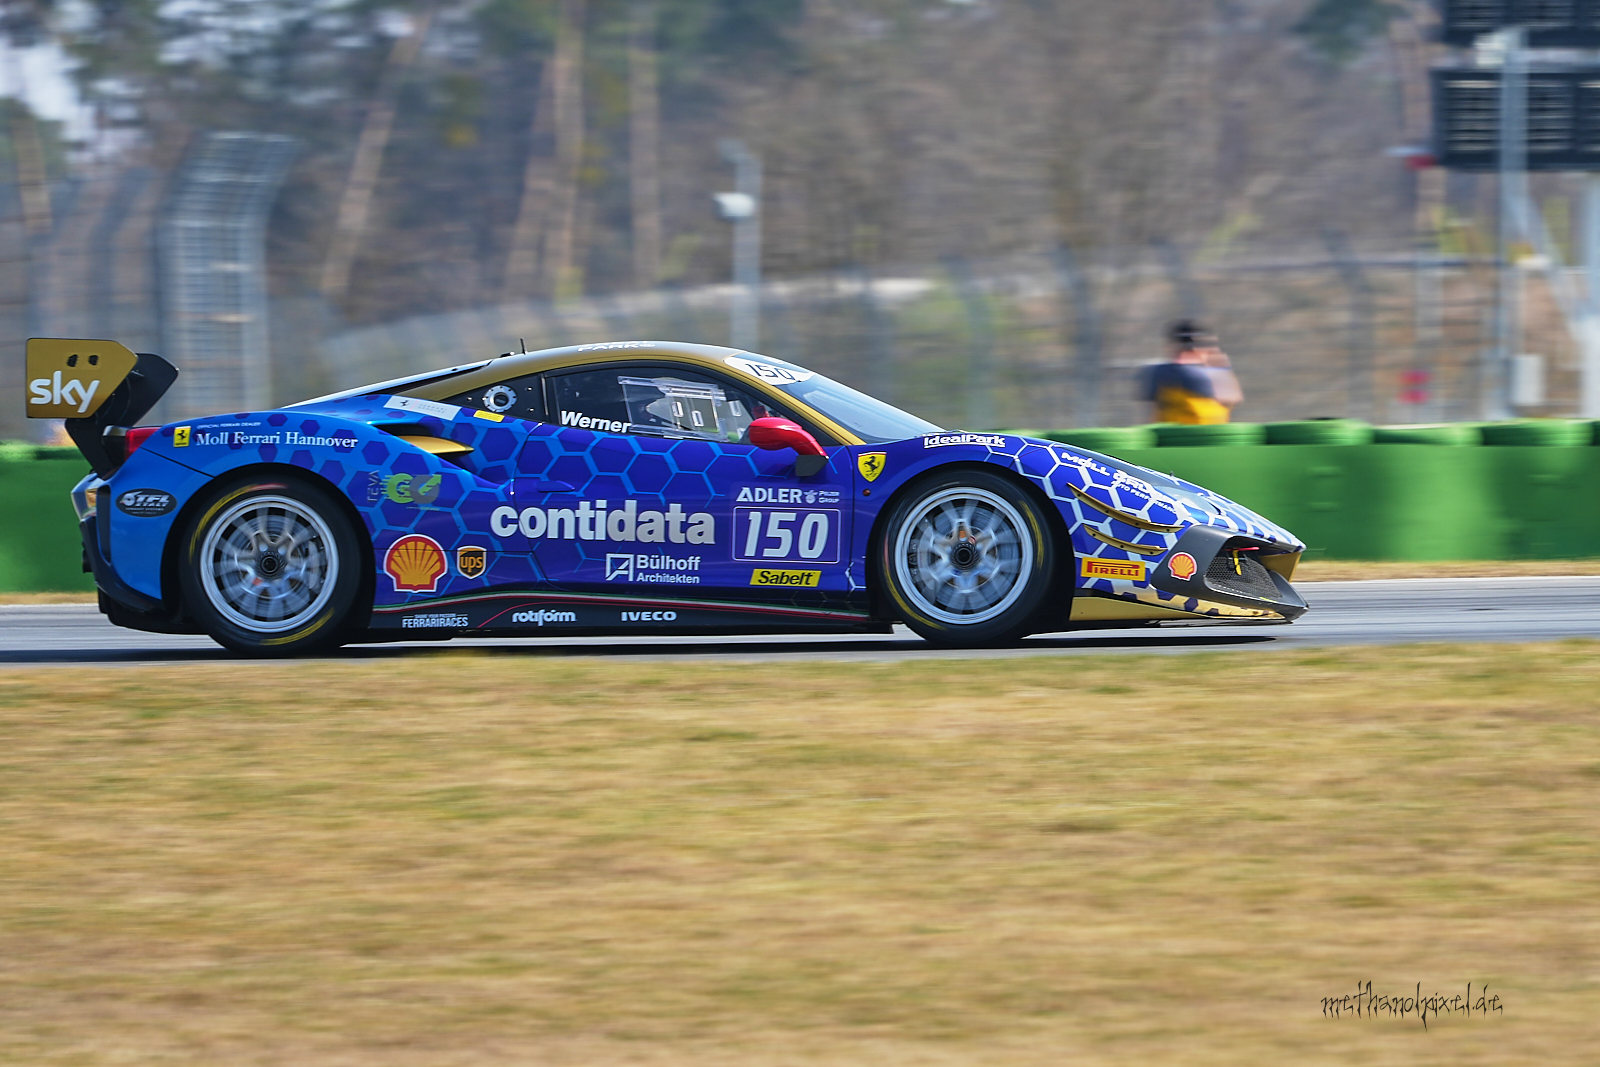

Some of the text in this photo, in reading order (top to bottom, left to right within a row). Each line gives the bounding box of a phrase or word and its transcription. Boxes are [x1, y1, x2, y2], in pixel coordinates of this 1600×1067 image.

[746, 363, 796, 380] 150
[29, 370, 100, 413] sky
[561, 410, 632, 433] Werner
[196, 431, 358, 448] Moll Ferrari Hannover
[924, 434, 1006, 446] IdealPark
[736, 487, 803, 504] ADLER
[490, 500, 716, 544] contidata
[744, 511, 829, 559] 150
[460, 556, 484, 573] ups
[636, 554, 701, 571] Bülhoff
[1087, 561, 1140, 577] PIRELLI
[636, 572, 700, 584] Architekten
[758, 570, 814, 586] Sabelt
[402, 617, 468, 628] FERRARIRACES
[621, 611, 678, 622] IVECO
